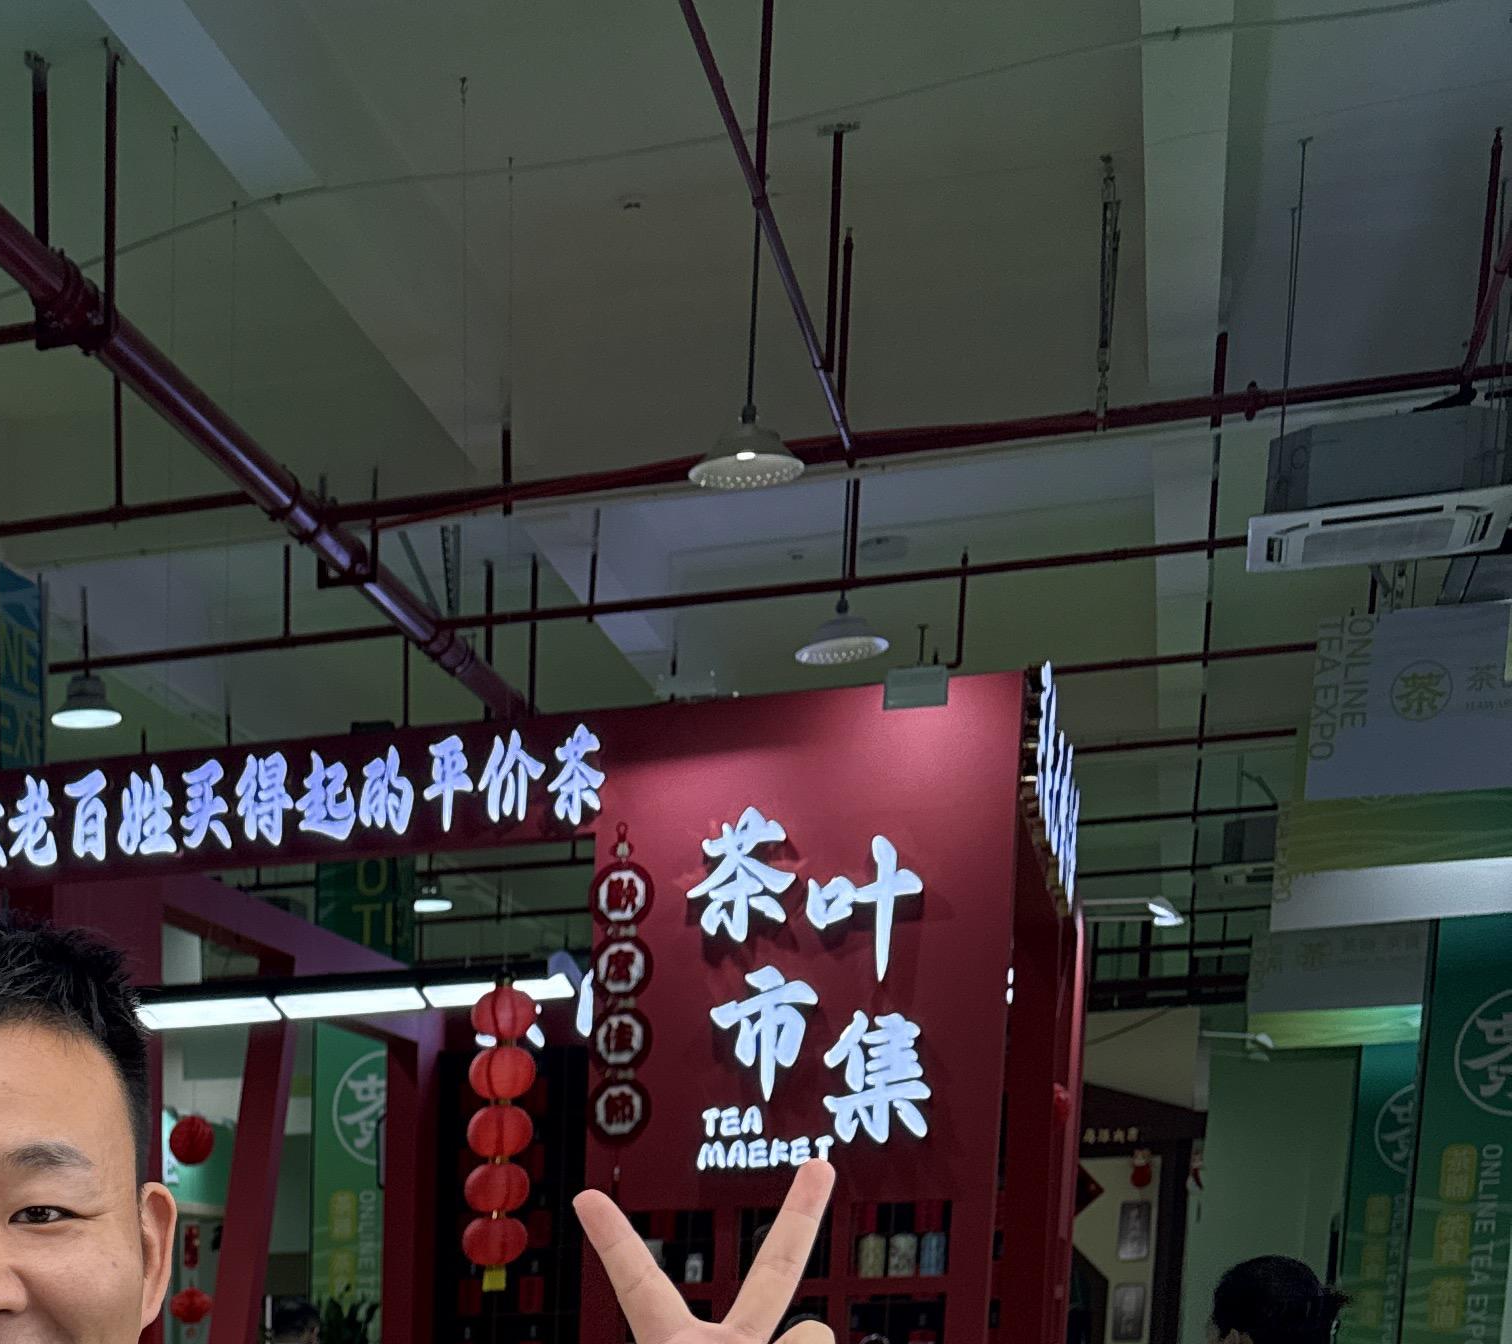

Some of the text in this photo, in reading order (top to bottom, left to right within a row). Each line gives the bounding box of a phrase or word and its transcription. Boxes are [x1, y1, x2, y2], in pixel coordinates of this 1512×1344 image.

[1308, 616, 1345, 762] TEA EXPO
[1340, 613, 1375, 730] ONLINE
[686, 805, 924, 983] 茶叶
[709, 965, 932, 1144] 市集
[701, 1105, 763, 1137] TEA
[1472, 1143, 1504, 1236] ONLINE
[1468, 1242, 1495, 1293] TEA
